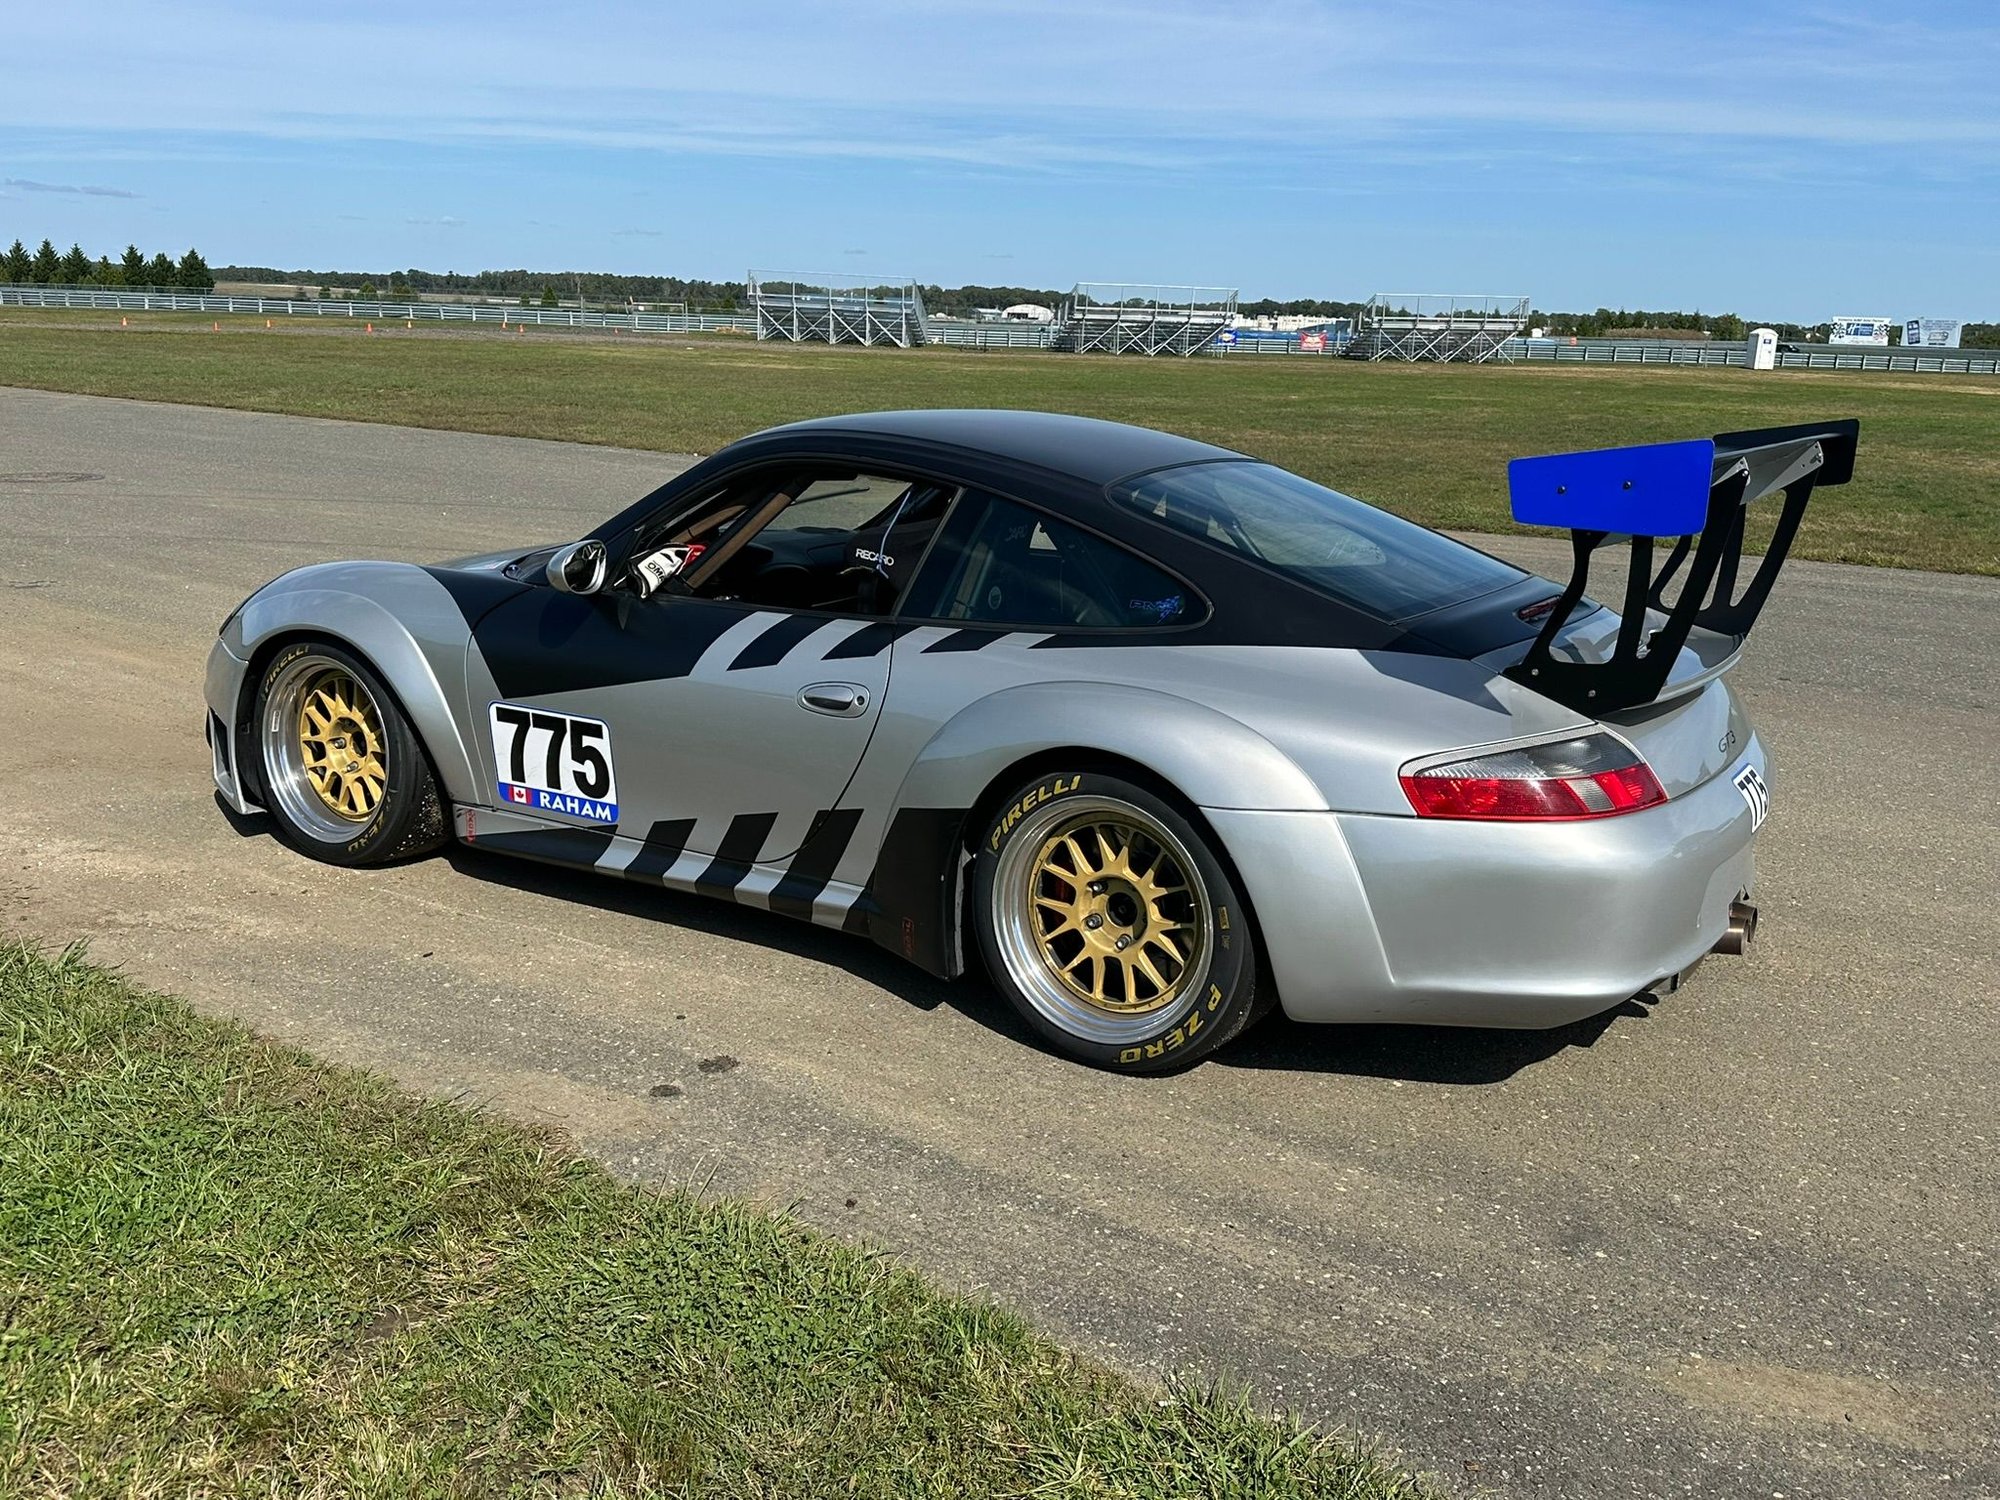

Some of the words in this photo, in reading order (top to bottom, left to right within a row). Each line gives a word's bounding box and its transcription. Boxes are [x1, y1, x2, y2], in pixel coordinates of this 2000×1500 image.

[856, 548, 894, 566] RECARO
[496, 706, 610, 800] 775
[1718, 730, 1736, 753] GT3
[539, 791, 612, 822] RAHAM
[990, 775, 1081, 851] PIRELLI
[1207, 983, 1223, 1012] P
[1119, 1010, 1204, 1064] ZERO
